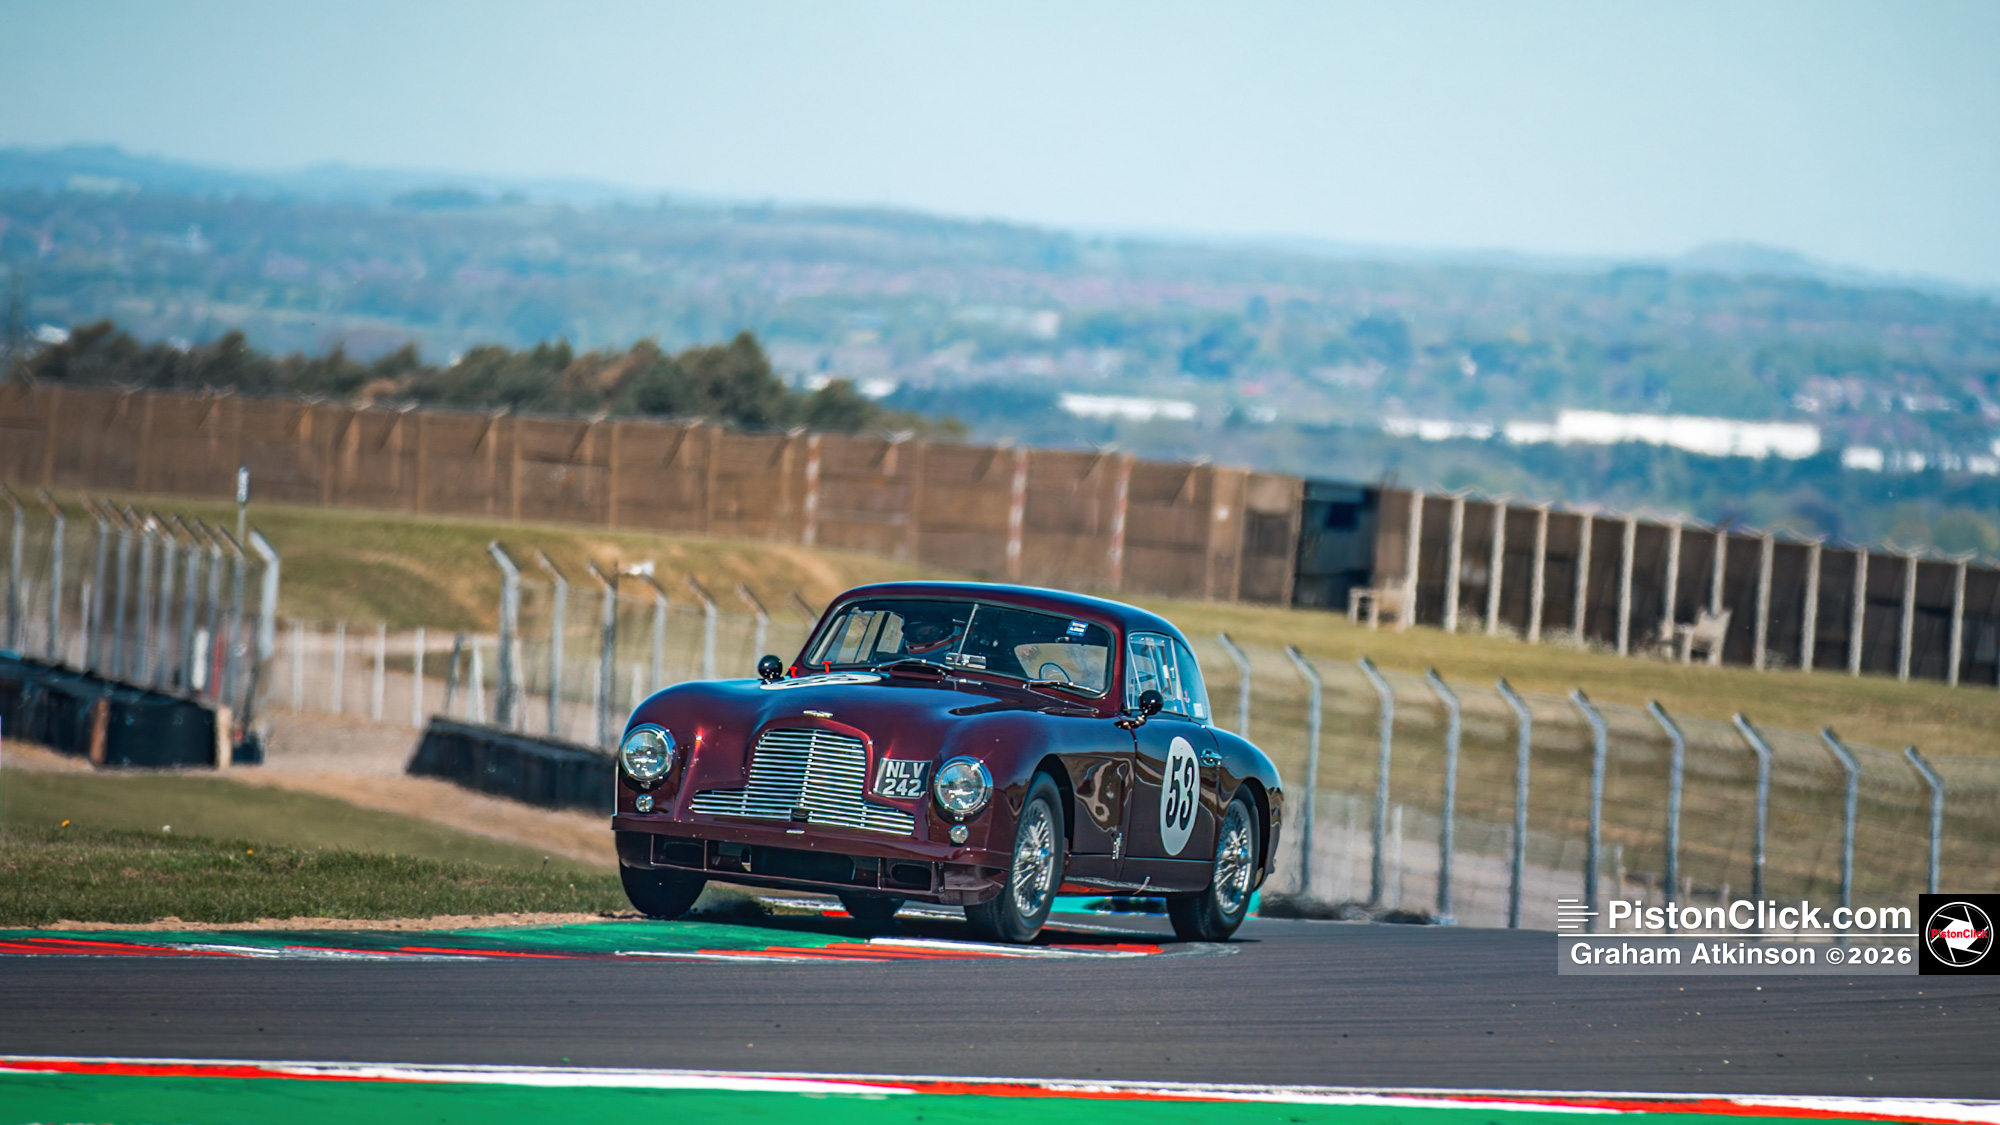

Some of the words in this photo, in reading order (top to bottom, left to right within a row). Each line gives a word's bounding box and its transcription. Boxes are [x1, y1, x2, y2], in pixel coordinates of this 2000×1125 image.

[886, 761, 925, 778] NLV
[882, 778, 921, 796] 242
[1165, 755, 1195, 831] 53
